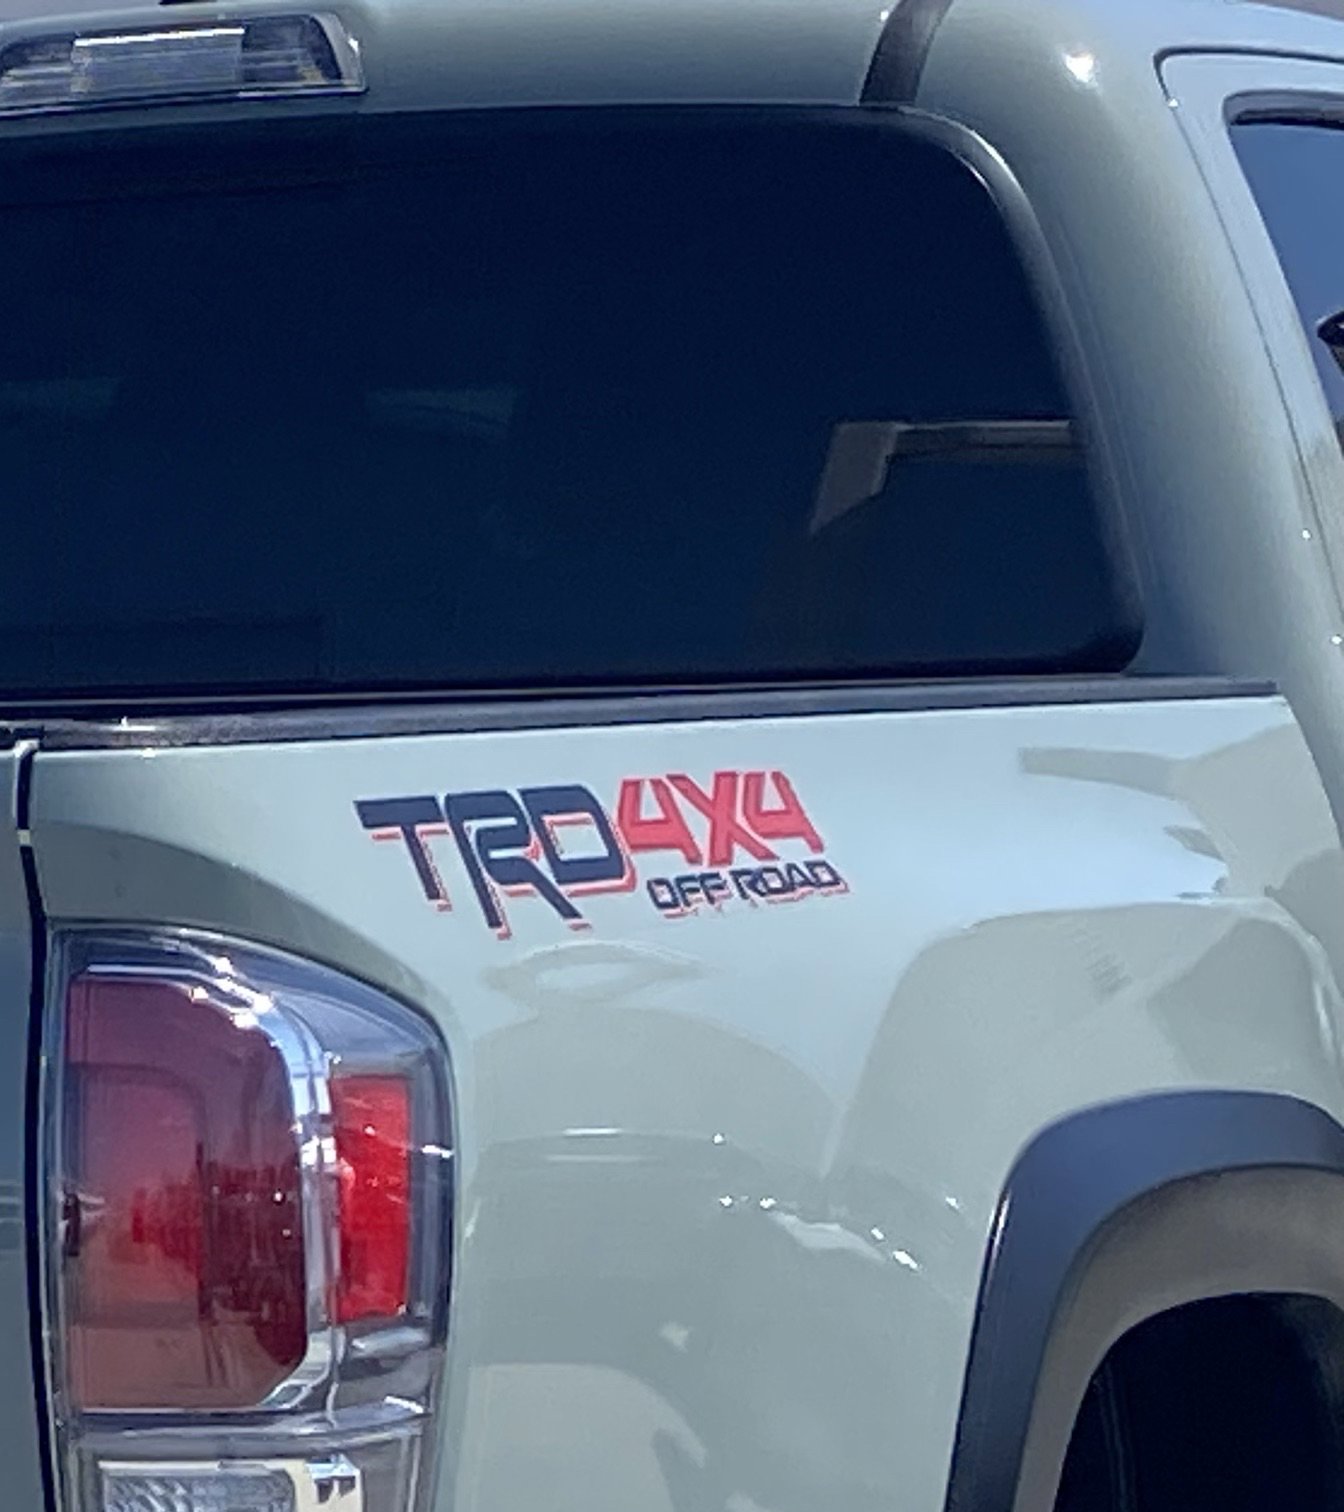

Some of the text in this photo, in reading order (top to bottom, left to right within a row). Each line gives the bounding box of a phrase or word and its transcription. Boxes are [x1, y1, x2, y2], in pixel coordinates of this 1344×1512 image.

[353, 784, 637, 939] TRD
[646, 859, 848, 917] OFF ROAD
